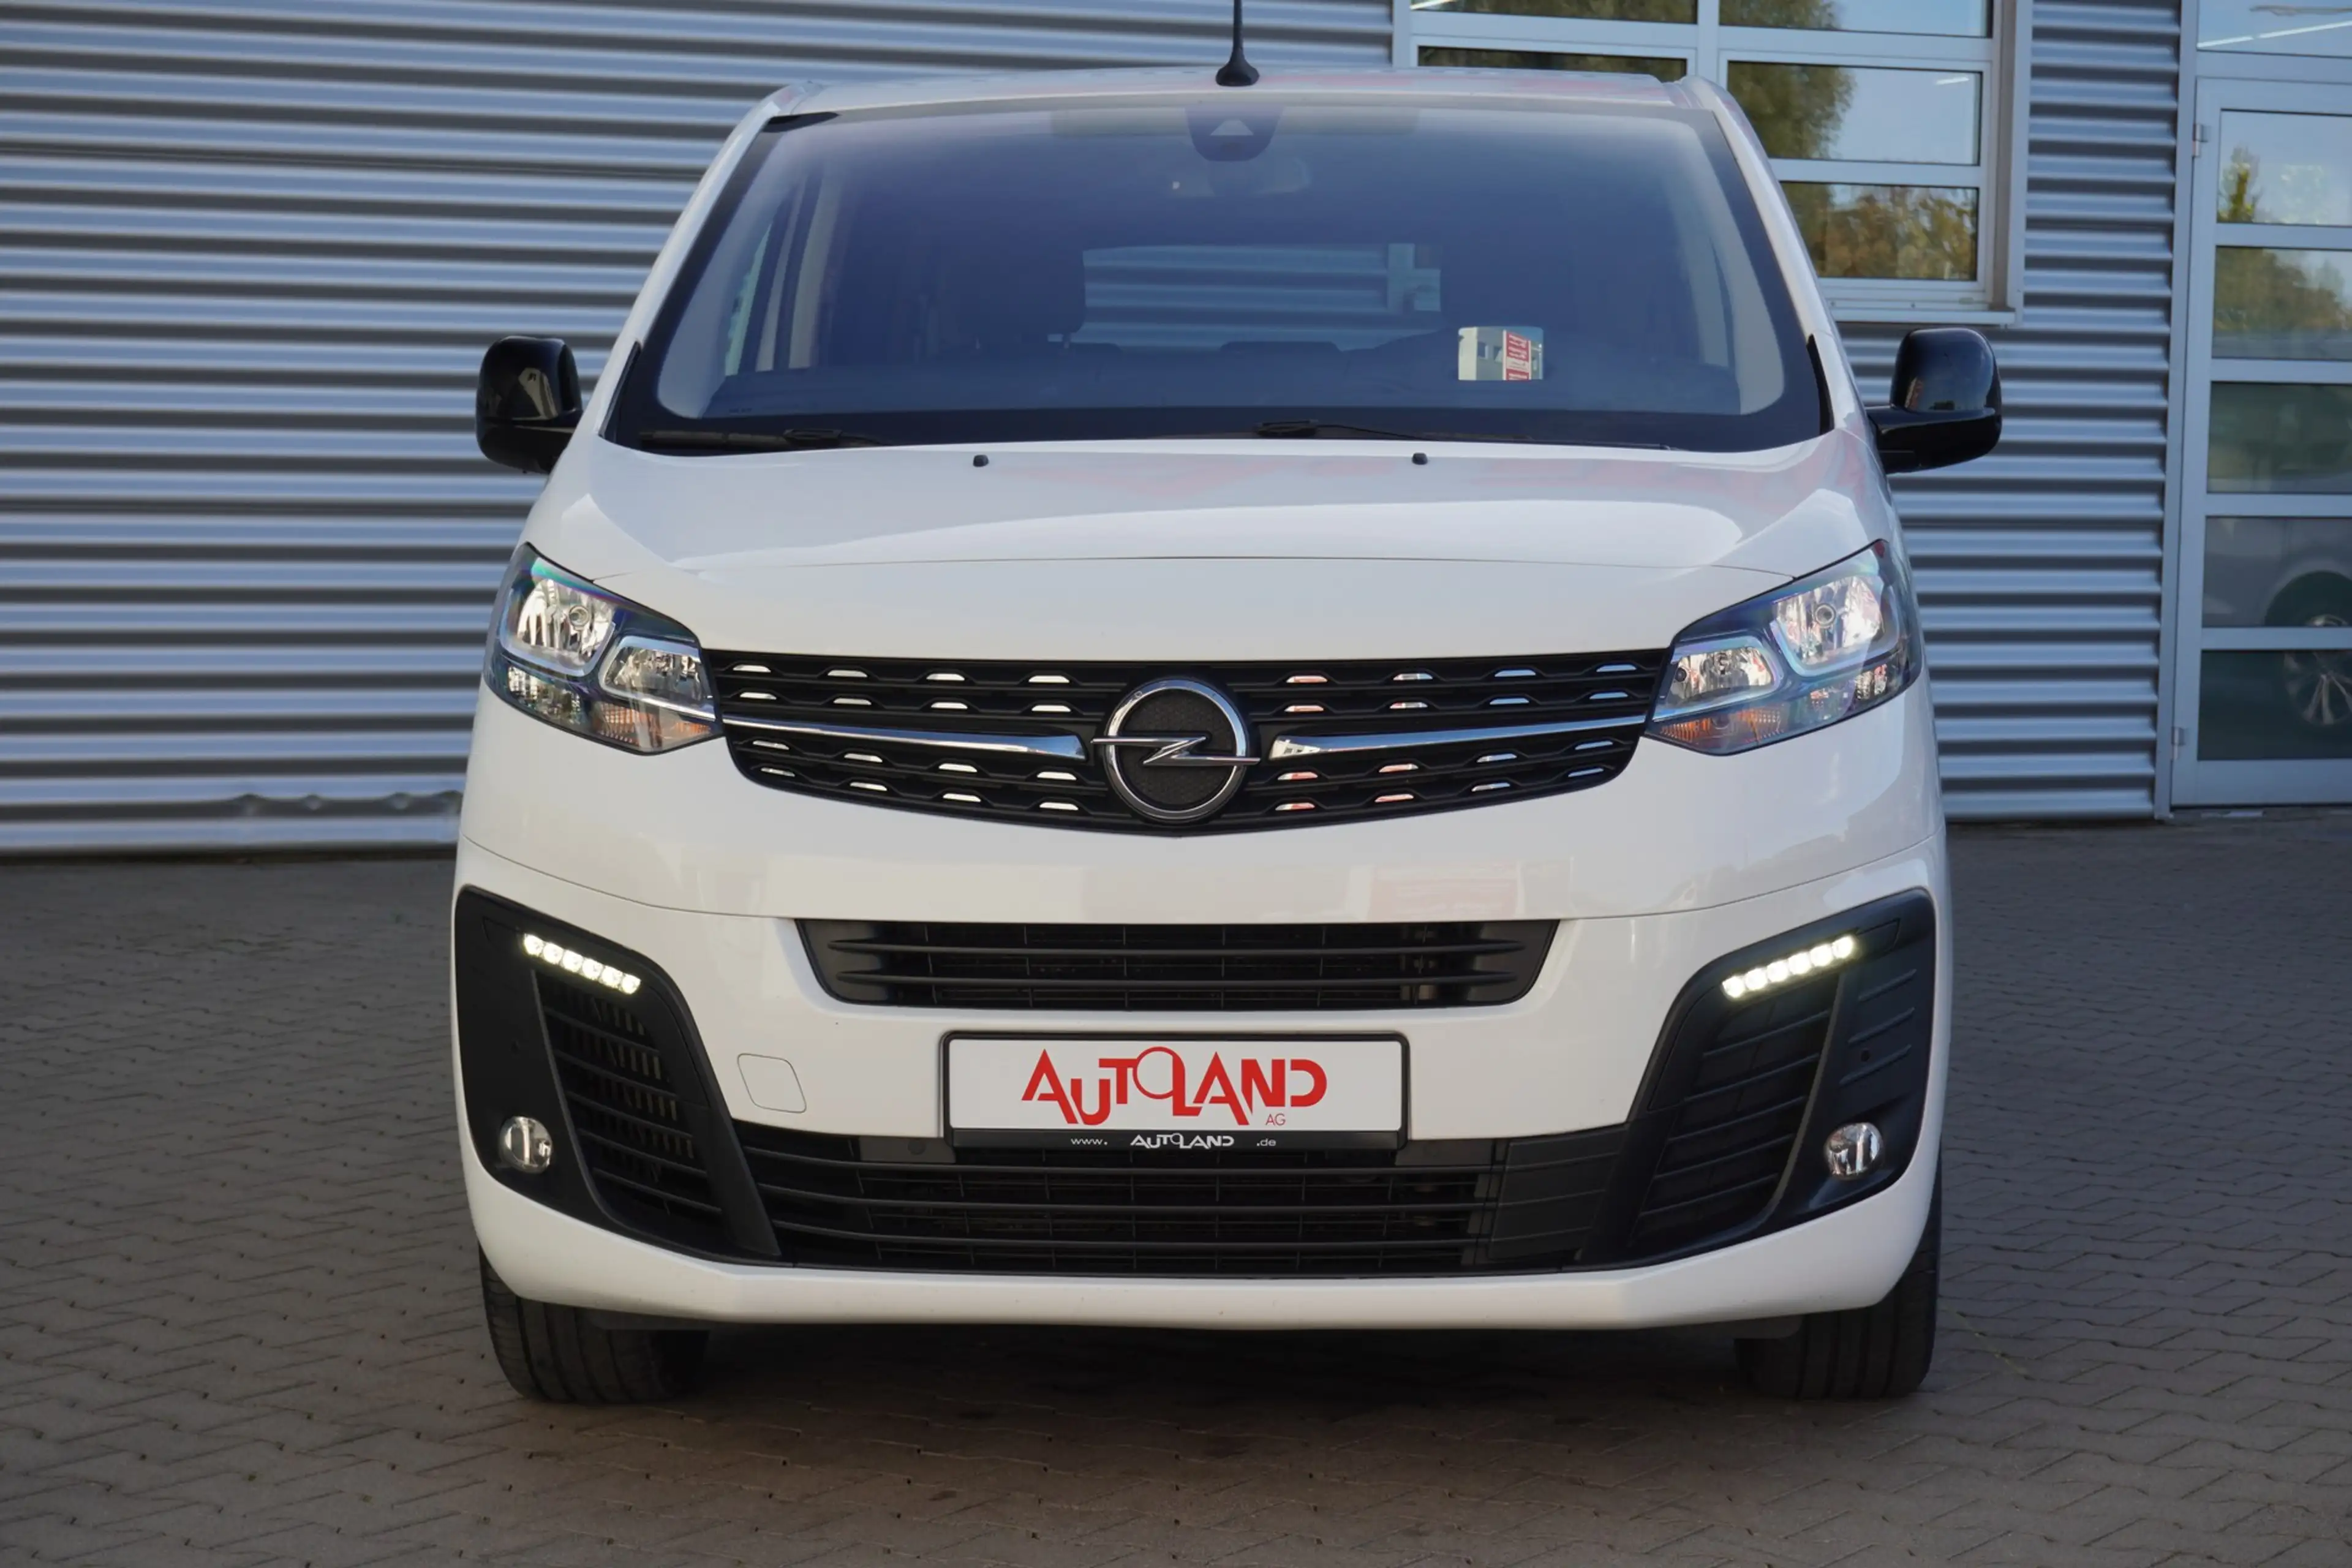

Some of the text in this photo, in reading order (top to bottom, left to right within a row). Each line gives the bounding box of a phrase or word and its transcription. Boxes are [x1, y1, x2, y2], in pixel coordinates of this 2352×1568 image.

[1021, 1046, 1328, 1126] AUTOLAND
[1265, 1113, 1286, 1126] AG
[1130, 1133, 1235, 1150] AUTOLAND
[1256, 1137, 1277, 1147] .de
